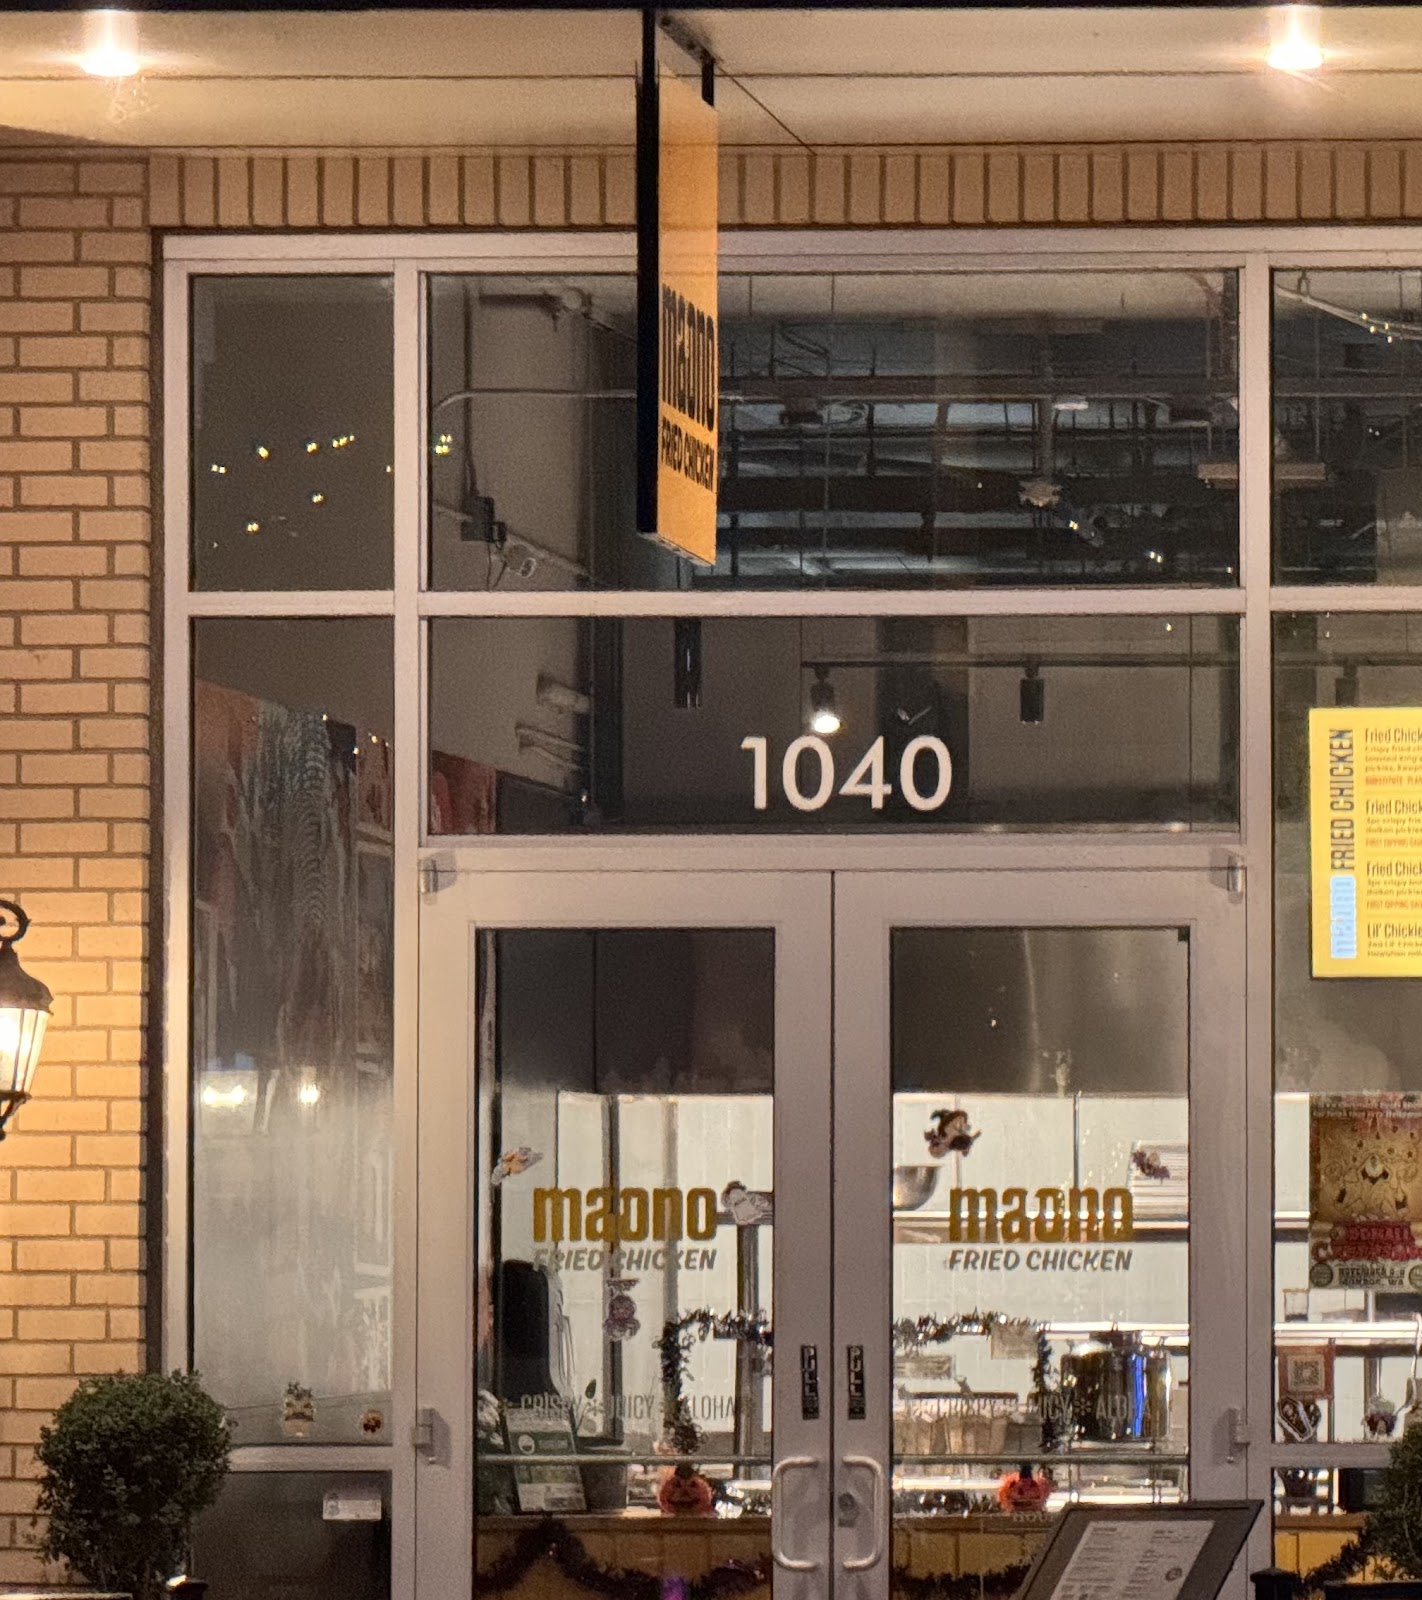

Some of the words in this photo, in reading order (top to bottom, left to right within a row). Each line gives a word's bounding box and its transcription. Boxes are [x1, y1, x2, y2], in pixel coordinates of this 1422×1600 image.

[662, 415, 683, 473] FRIED
[684, 431, 715, 493] CHICKEN
[1365, 728, 1391, 743] Fried
[741, 735, 952, 811] 1040
[1330, 729, 1355, 811] CHICKEN
[1366, 800, 1391, 815] Fried
[1331, 818, 1355, 870] FRIED
[1367, 861, 1392, 876] Fried
[533, 1187, 718, 1243] maono
[949, 1187, 1134, 1243] maono
[535, 1247, 600, 1271] FRIED
[613, 1248, 717, 1271] CHICKEN
[949, 1249, 1021, 1271] FRIED
[1026, 1249, 1134, 1271] CHICKEN
[804, 1346, 817, 1396] PULL
[850, 1346, 862, 1396] PULL
